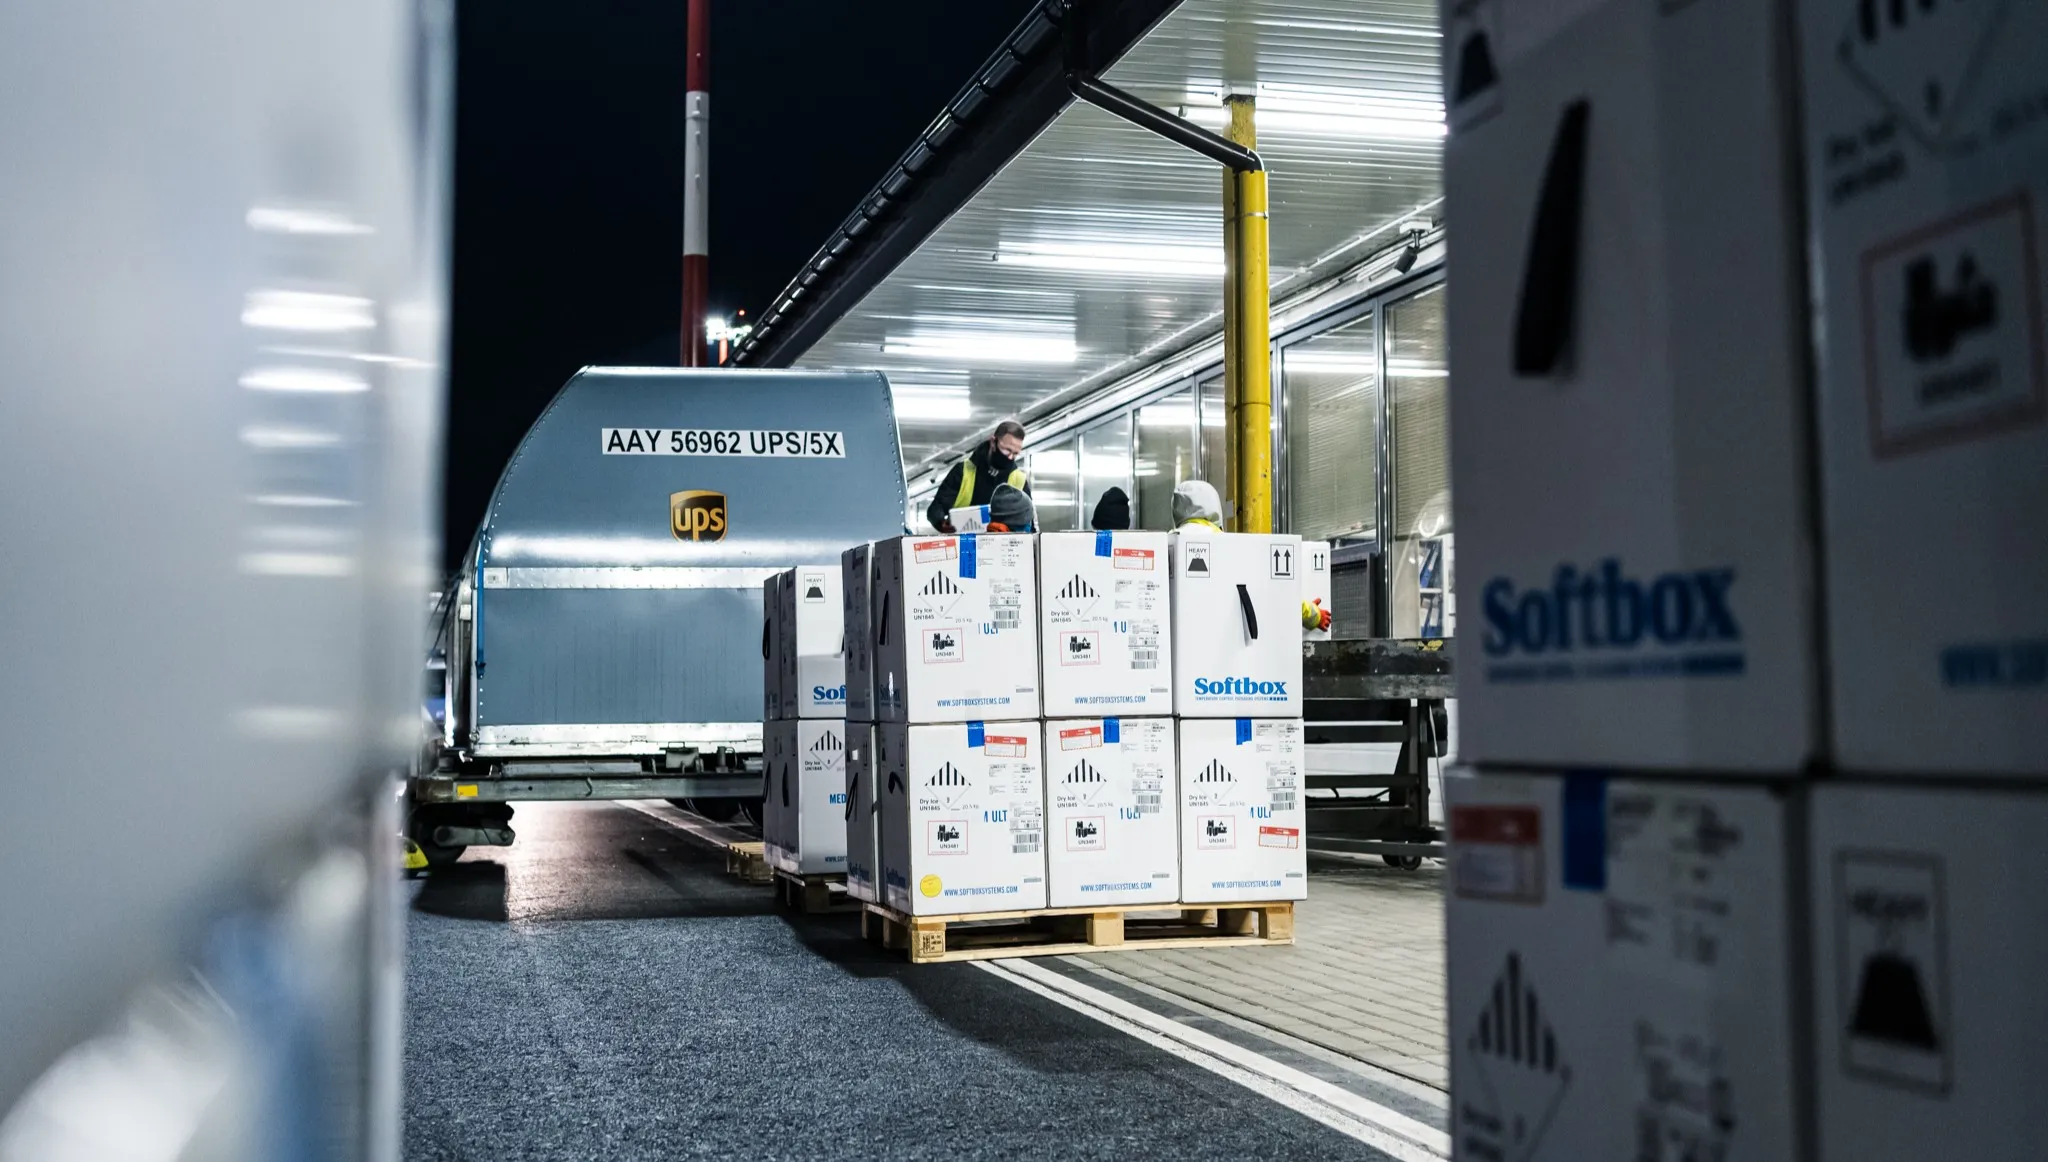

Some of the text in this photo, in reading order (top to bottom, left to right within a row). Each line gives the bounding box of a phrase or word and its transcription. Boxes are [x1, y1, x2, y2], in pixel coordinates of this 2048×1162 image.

[607, 430, 841, 455] AAY 56962 UPS/5X
[674, 508, 724, 541] ups
[1482, 557, 1742, 656] Softbox
[1194, 677, 1288, 695] Softbox
[937, 697, 1011, 707] WWW.SOFTBOXSYSTEMS.COM
[992, 810, 1008, 822] ULT
[944, 886, 1018, 897] WWW.SOFTBOXSYSTEMS.COM
[1212, 880, 1281, 889] WWW.SOFTBOXSYSTEMS.COM
